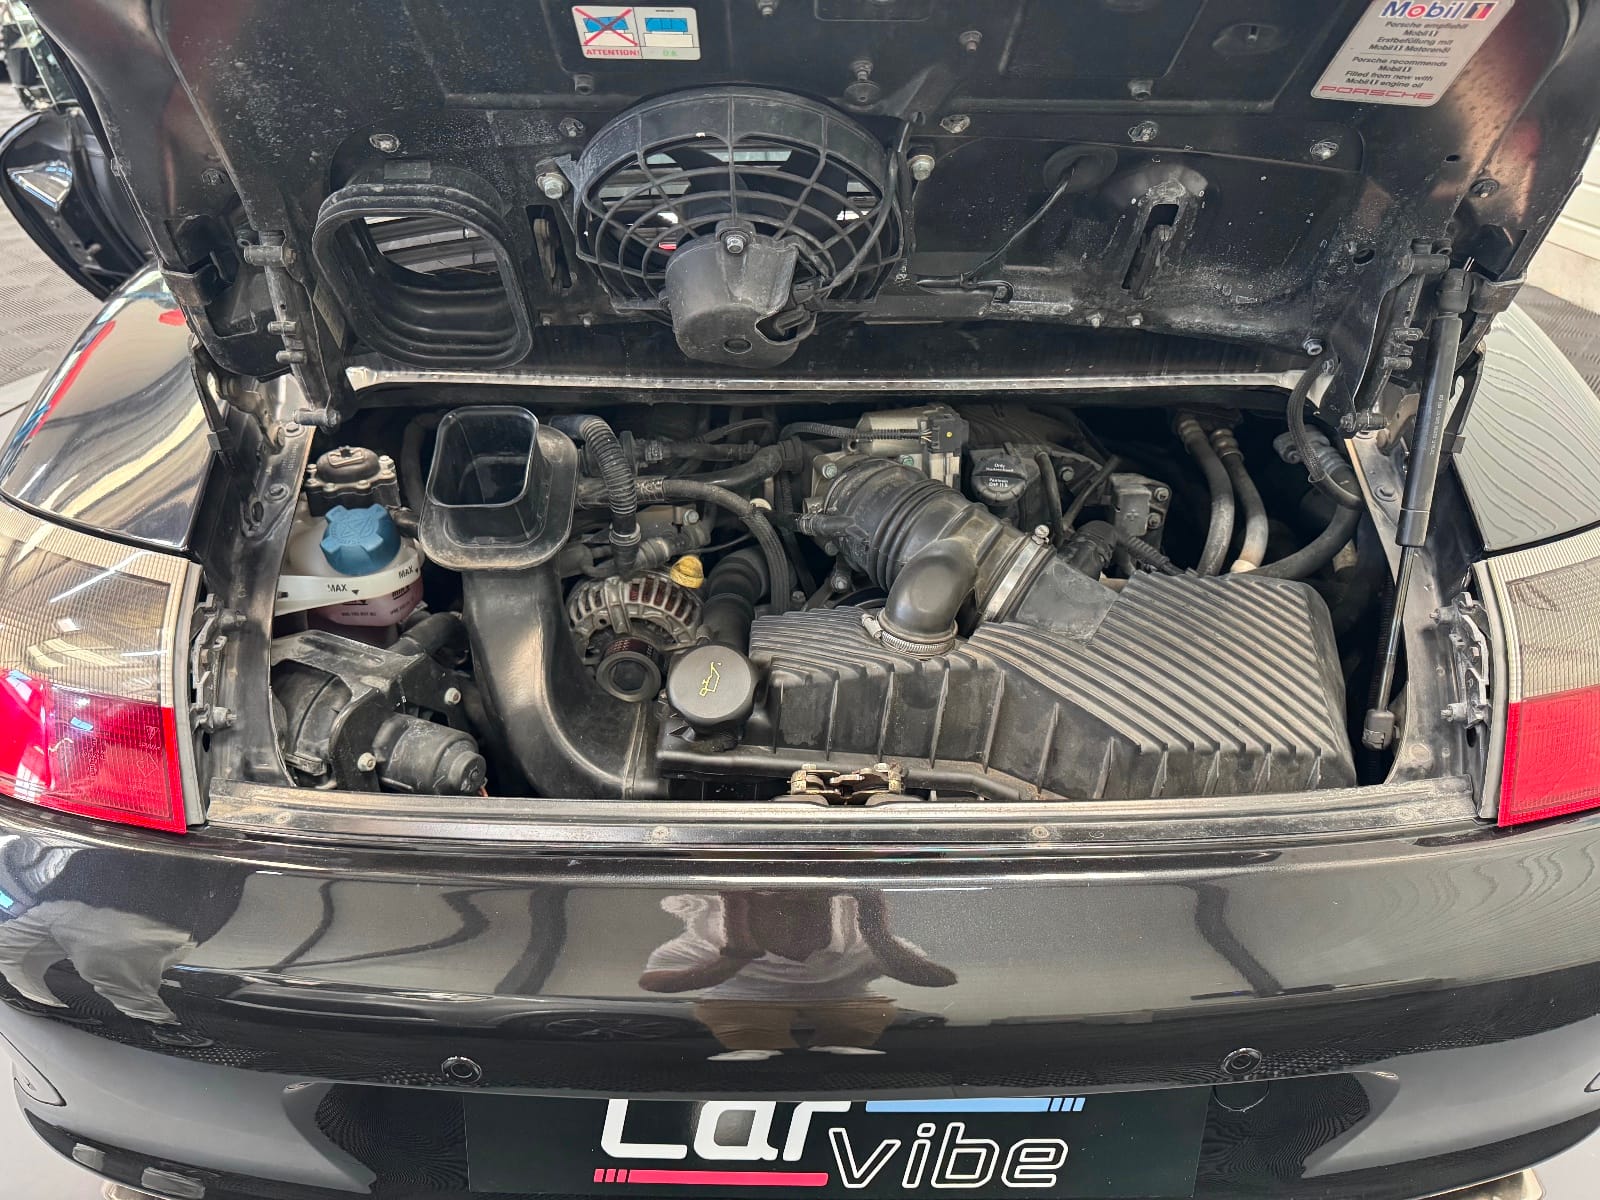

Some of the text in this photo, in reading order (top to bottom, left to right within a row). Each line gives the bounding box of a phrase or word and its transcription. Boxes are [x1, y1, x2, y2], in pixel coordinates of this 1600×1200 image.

[1381, 1, 1464, 19] Mobil
[1385, 21, 1422, 29] Porsche
[1377, 37, 1436, 46] Erstbefüllung
[1389, 59, 1447, 67] recommends
[1320, 85, 1436, 99] PORSCHE
[398, 565, 414, 578] MAX
[328, 584, 348, 593] MAX
[828, 1122, 1069, 1189] vibe
